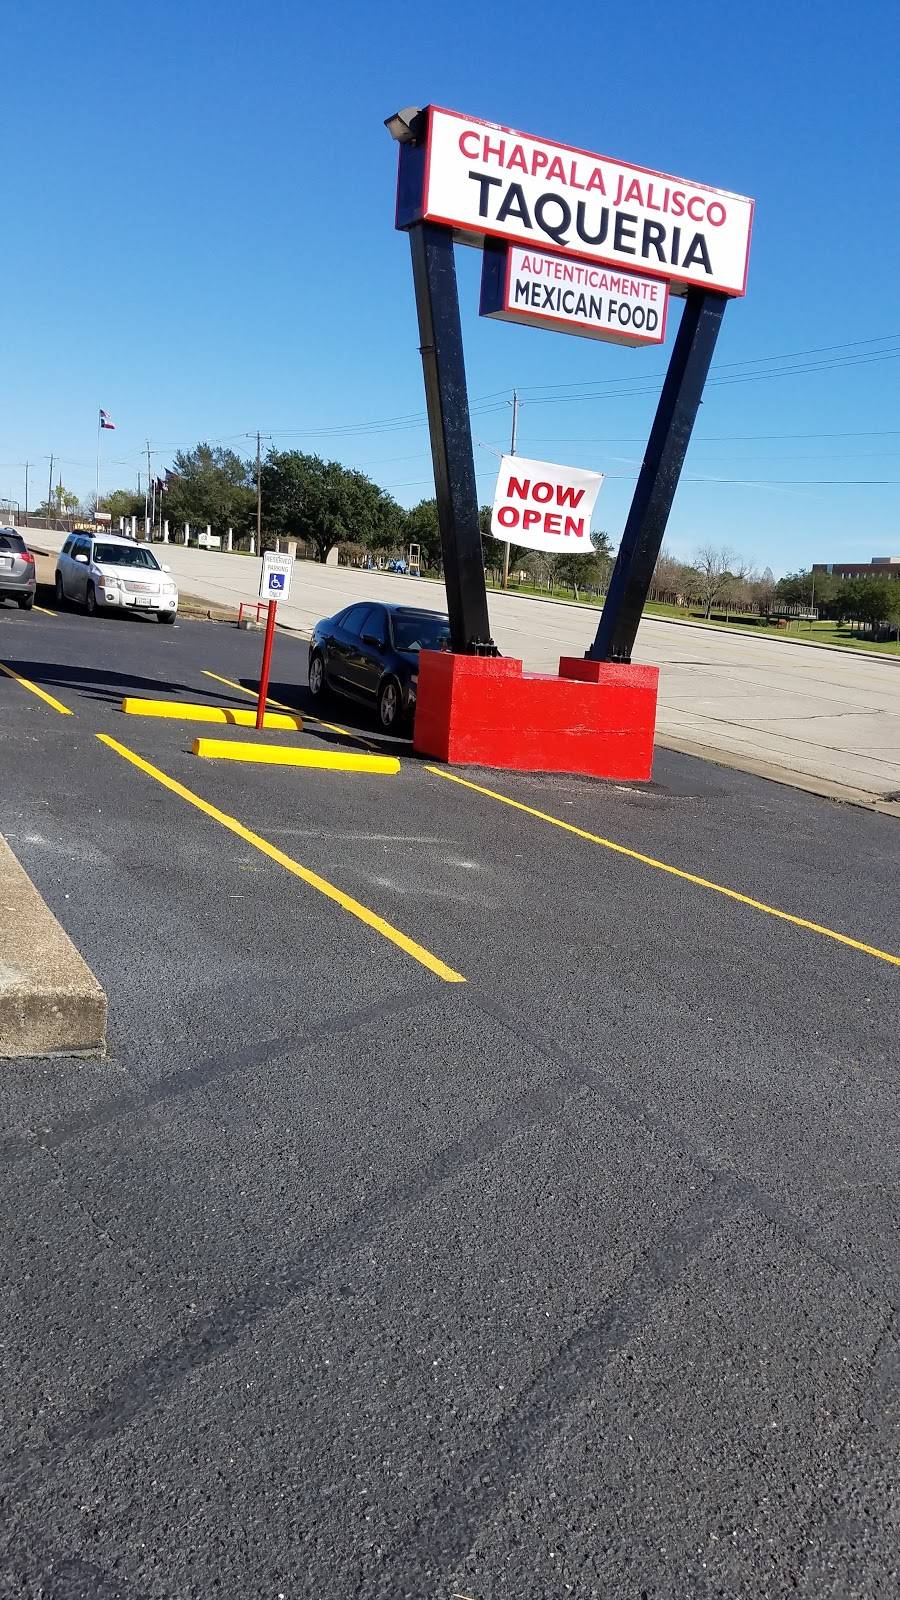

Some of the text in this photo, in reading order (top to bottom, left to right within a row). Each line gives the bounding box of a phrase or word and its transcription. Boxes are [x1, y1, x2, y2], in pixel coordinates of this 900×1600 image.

[459, 130, 727, 227] CHAPALA JALISCO
[468, 171, 714, 276] TAQUERIA
[520, 255, 658, 302] AUTENTICAMENTE
[514, 278, 659, 331] MEXICAN FOOD
[506, 477, 586, 508] NOW
[497, 506, 584, 537] OPEN
[265, 555, 291, 565] RESERVED
[268, 564, 288, 572] PARKING
